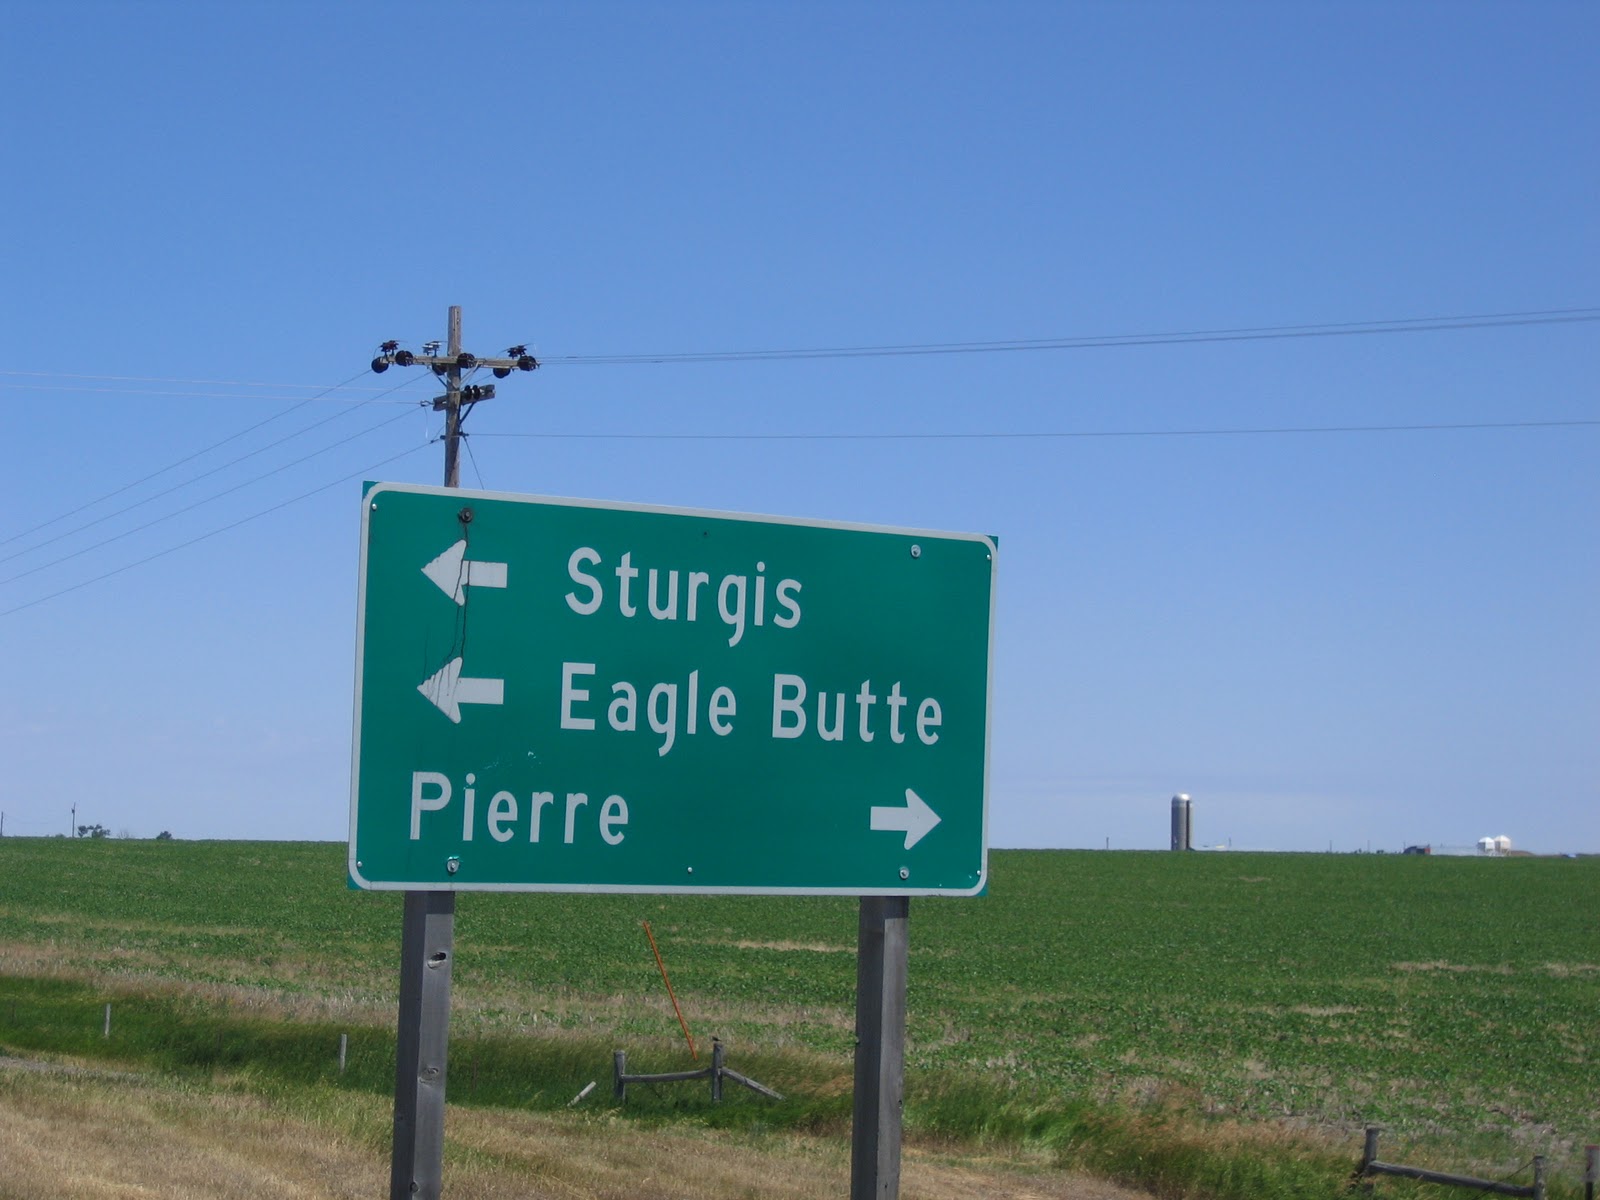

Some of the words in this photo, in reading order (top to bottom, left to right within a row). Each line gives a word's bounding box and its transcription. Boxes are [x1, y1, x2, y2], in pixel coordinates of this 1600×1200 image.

[564, 546, 803, 648] Sturgis
[559, 661, 737, 758] Eagle
[770, 673, 943, 746] Butte
[409, 770, 630, 847] Pierre
